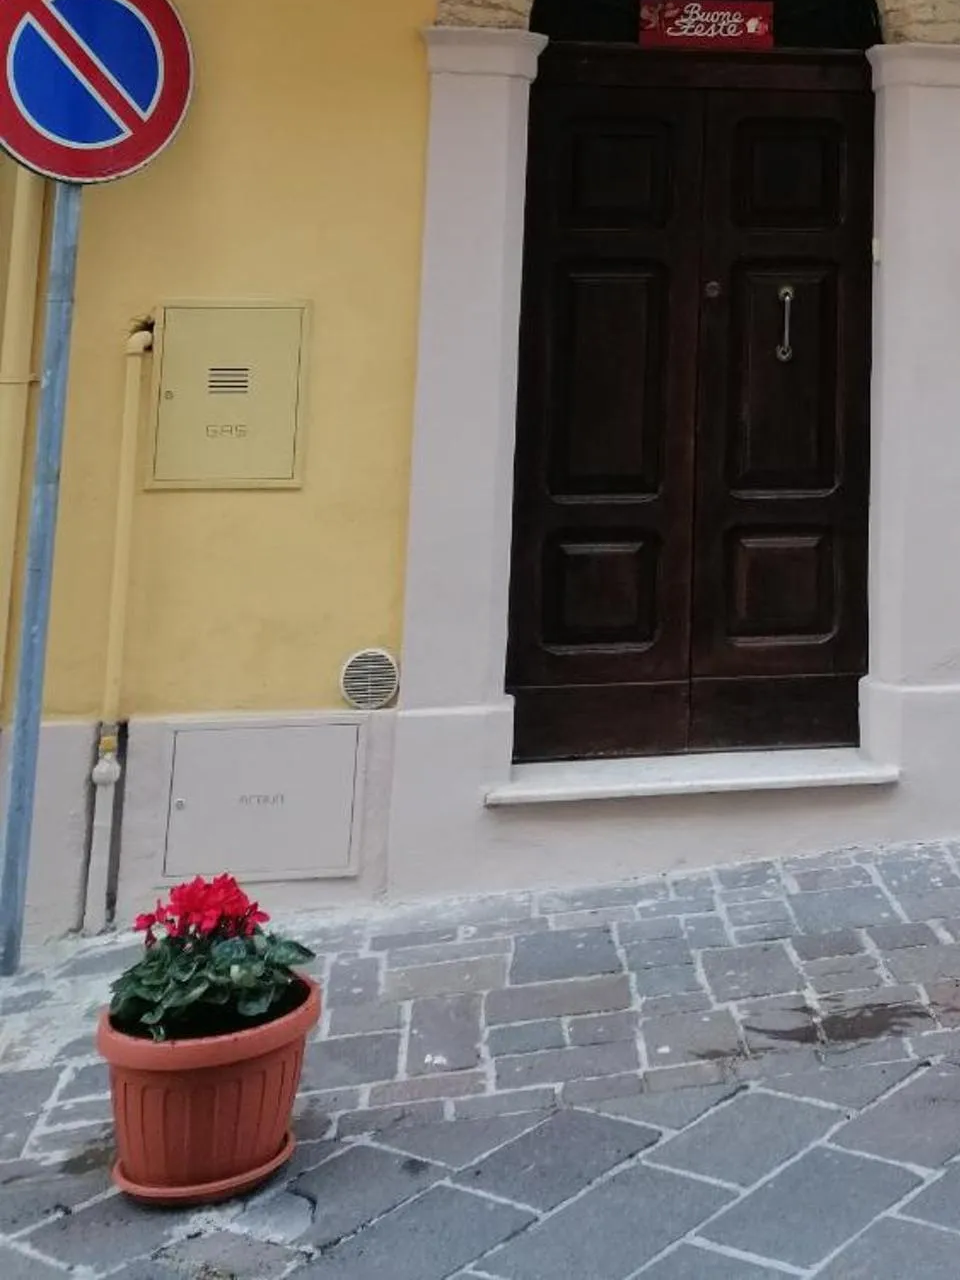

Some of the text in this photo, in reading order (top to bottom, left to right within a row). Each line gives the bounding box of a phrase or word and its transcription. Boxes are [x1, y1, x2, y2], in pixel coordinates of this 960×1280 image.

[681, 3, 744, 23] Buone
[667, 19, 743, 37] Feste
[206, 424, 247, 438] GAS
